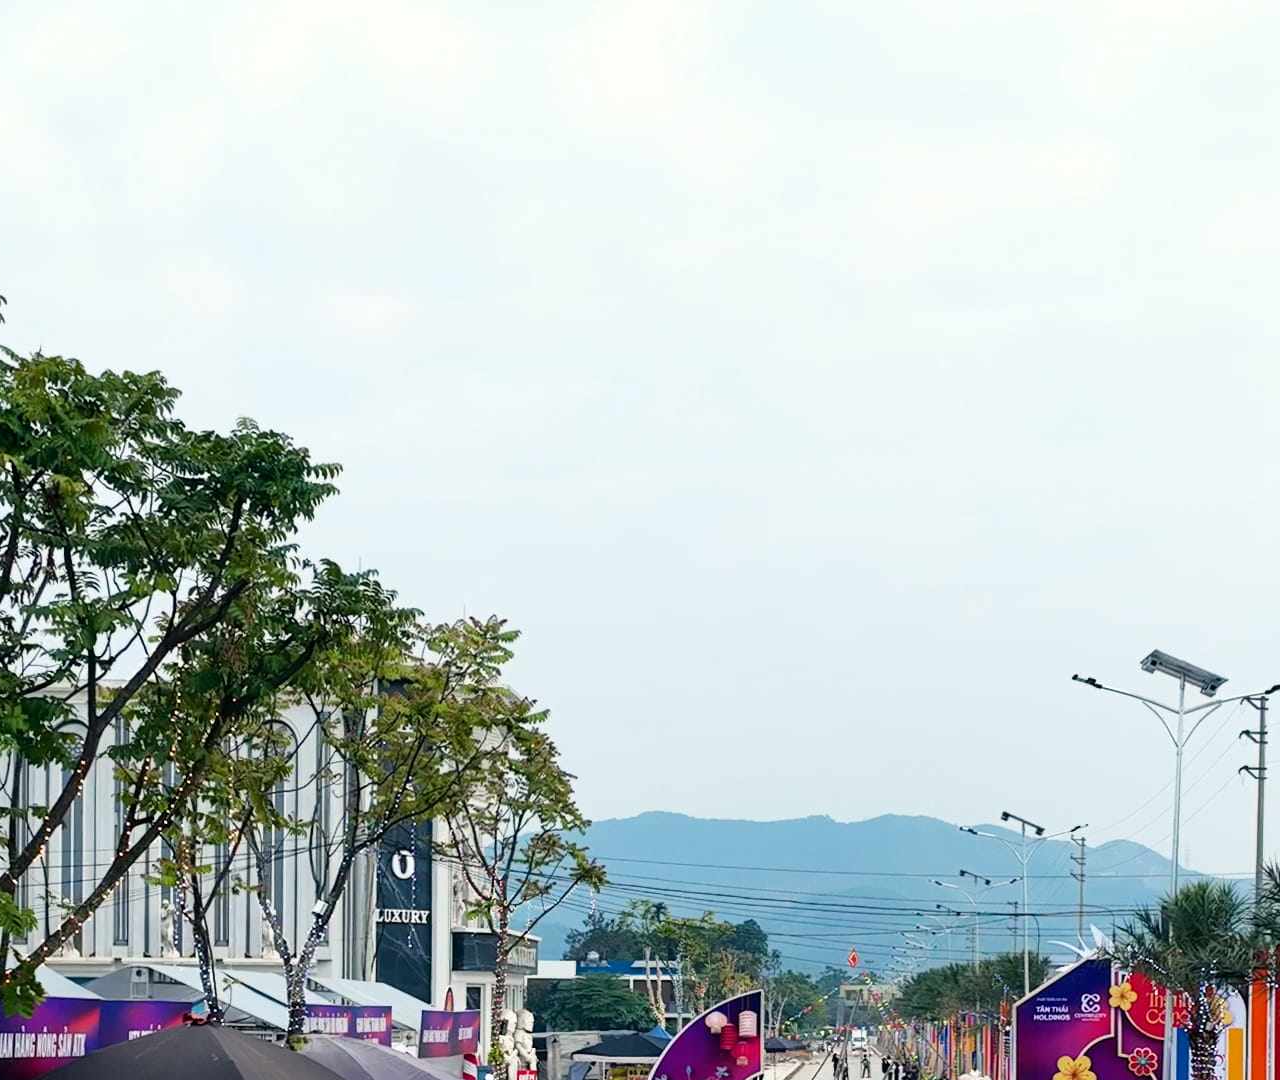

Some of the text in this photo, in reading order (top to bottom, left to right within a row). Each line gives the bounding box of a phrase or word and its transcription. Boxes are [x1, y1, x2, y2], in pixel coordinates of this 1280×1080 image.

[375, 908, 430, 924] LUXURY
[15, 1025, 36, 1058] HÀNG
[37, 1026, 57, 1057] NÔNG
[58, 1026, 72, 1057] SẢN
[73, 1033, 87, 1057] ATK
